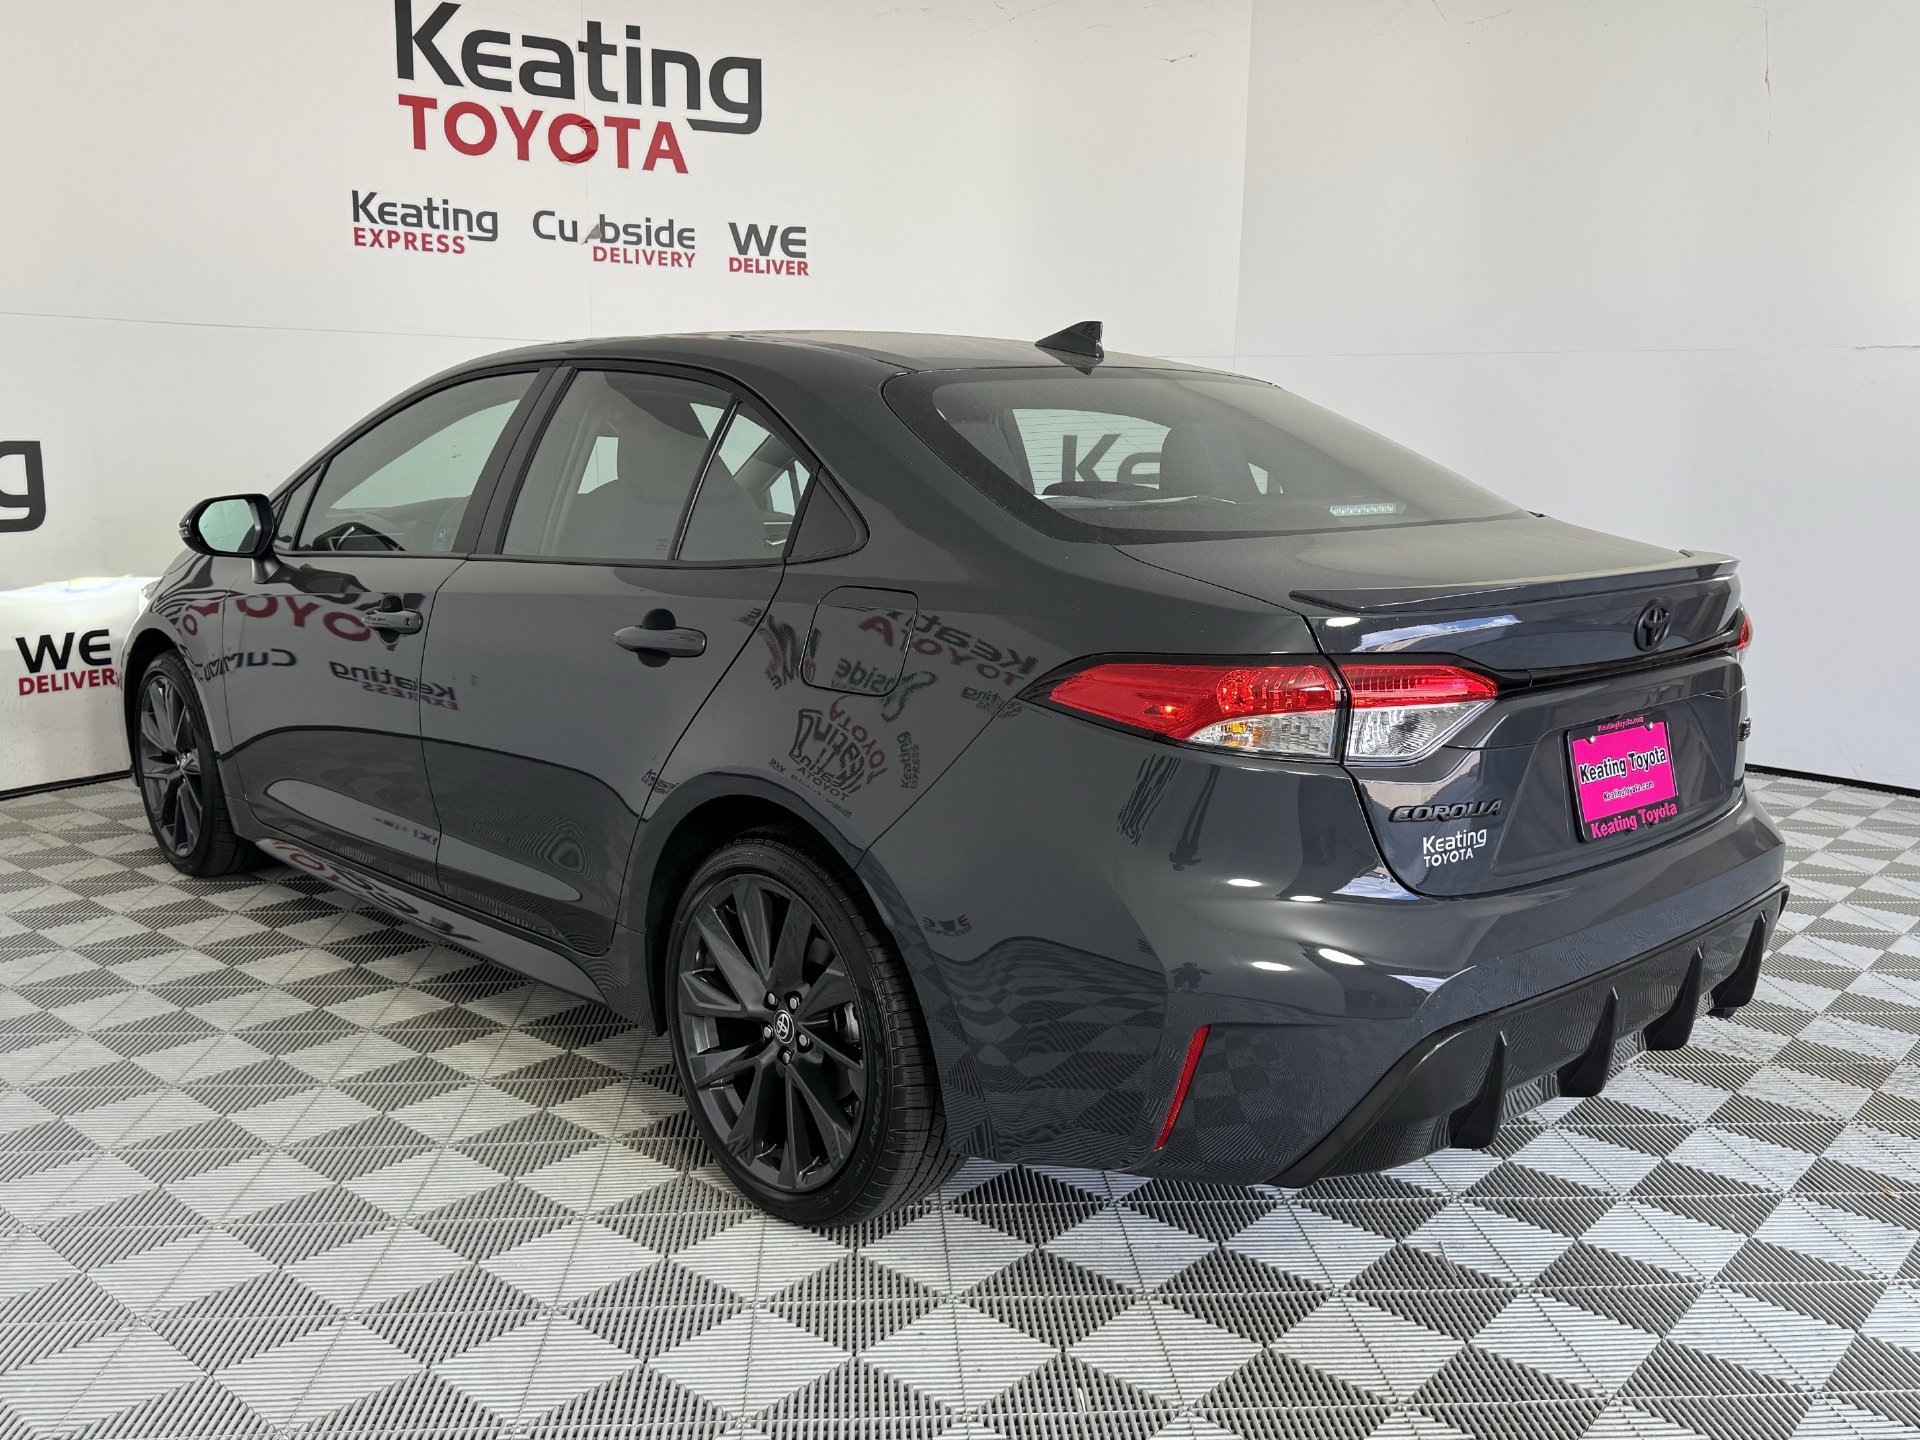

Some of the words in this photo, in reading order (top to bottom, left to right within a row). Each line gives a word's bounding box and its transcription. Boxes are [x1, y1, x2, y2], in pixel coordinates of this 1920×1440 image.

[394, 0, 762, 135] Keating
[398, 93, 689, 174] TOYOTA
[351, 190, 498, 242] Keating
[532, 210, 696, 250] Cubside
[353, 227, 466, 255] EXPRESS
[592, 245, 696, 268] DELIVERY
[728, 222, 807, 259] WE
[728, 257, 810, 277] DELIVER
[15, 629, 112, 673] WE
[18, 667, 117, 696] DELIVER
[1579, 756, 1627, 784] Keating
[1628, 746, 1668, 772] Toyota
[1388, 799, 1502, 822] COROLLA
[1590, 814, 1639, 839] Keating
[1637, 803, 1678, 825] Toyota
[1422, 828, 1487, 855] Keating
[1423, 847, 1474, 868] TOYOTA
